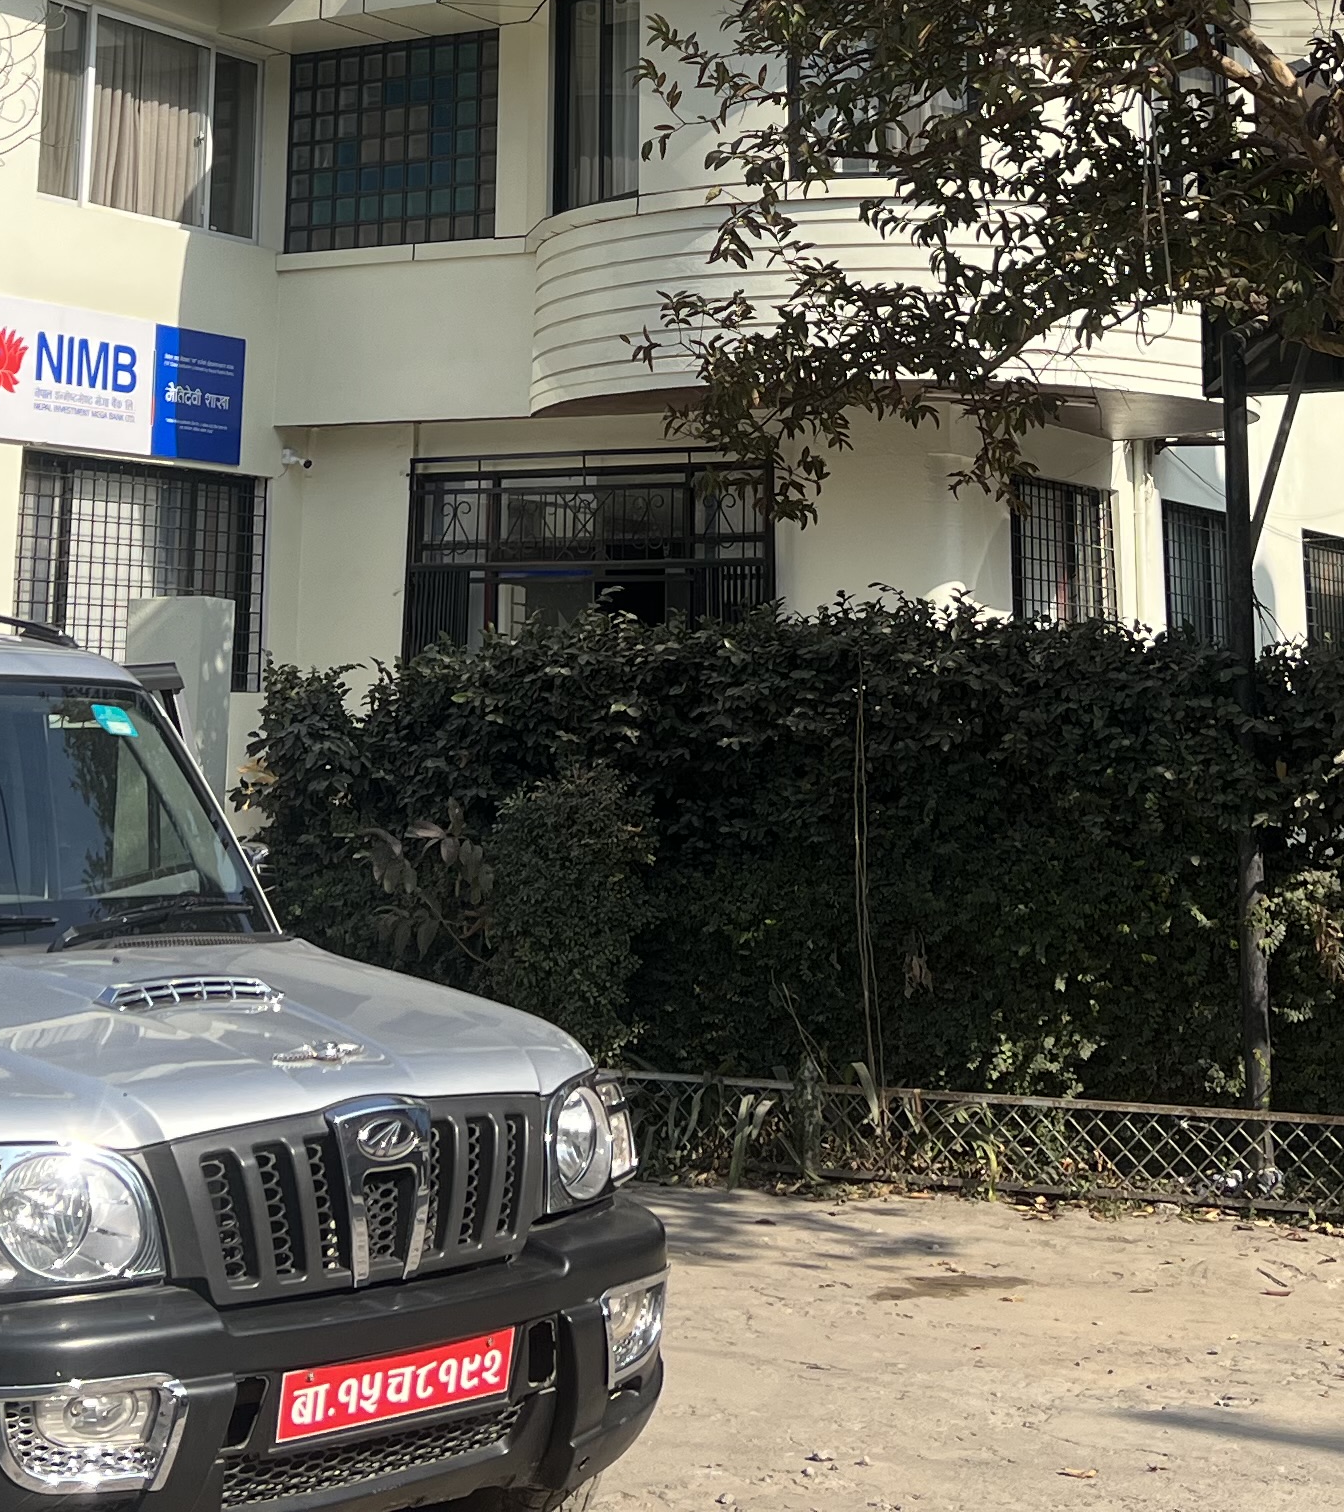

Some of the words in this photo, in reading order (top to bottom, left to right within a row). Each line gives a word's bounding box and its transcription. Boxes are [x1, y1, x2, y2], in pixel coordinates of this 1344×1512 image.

[35, 331, 137, 394] NIMB
[164, 382, 202, 406] मैतिदेवी
[205, 393, 230, 410] शाखा
